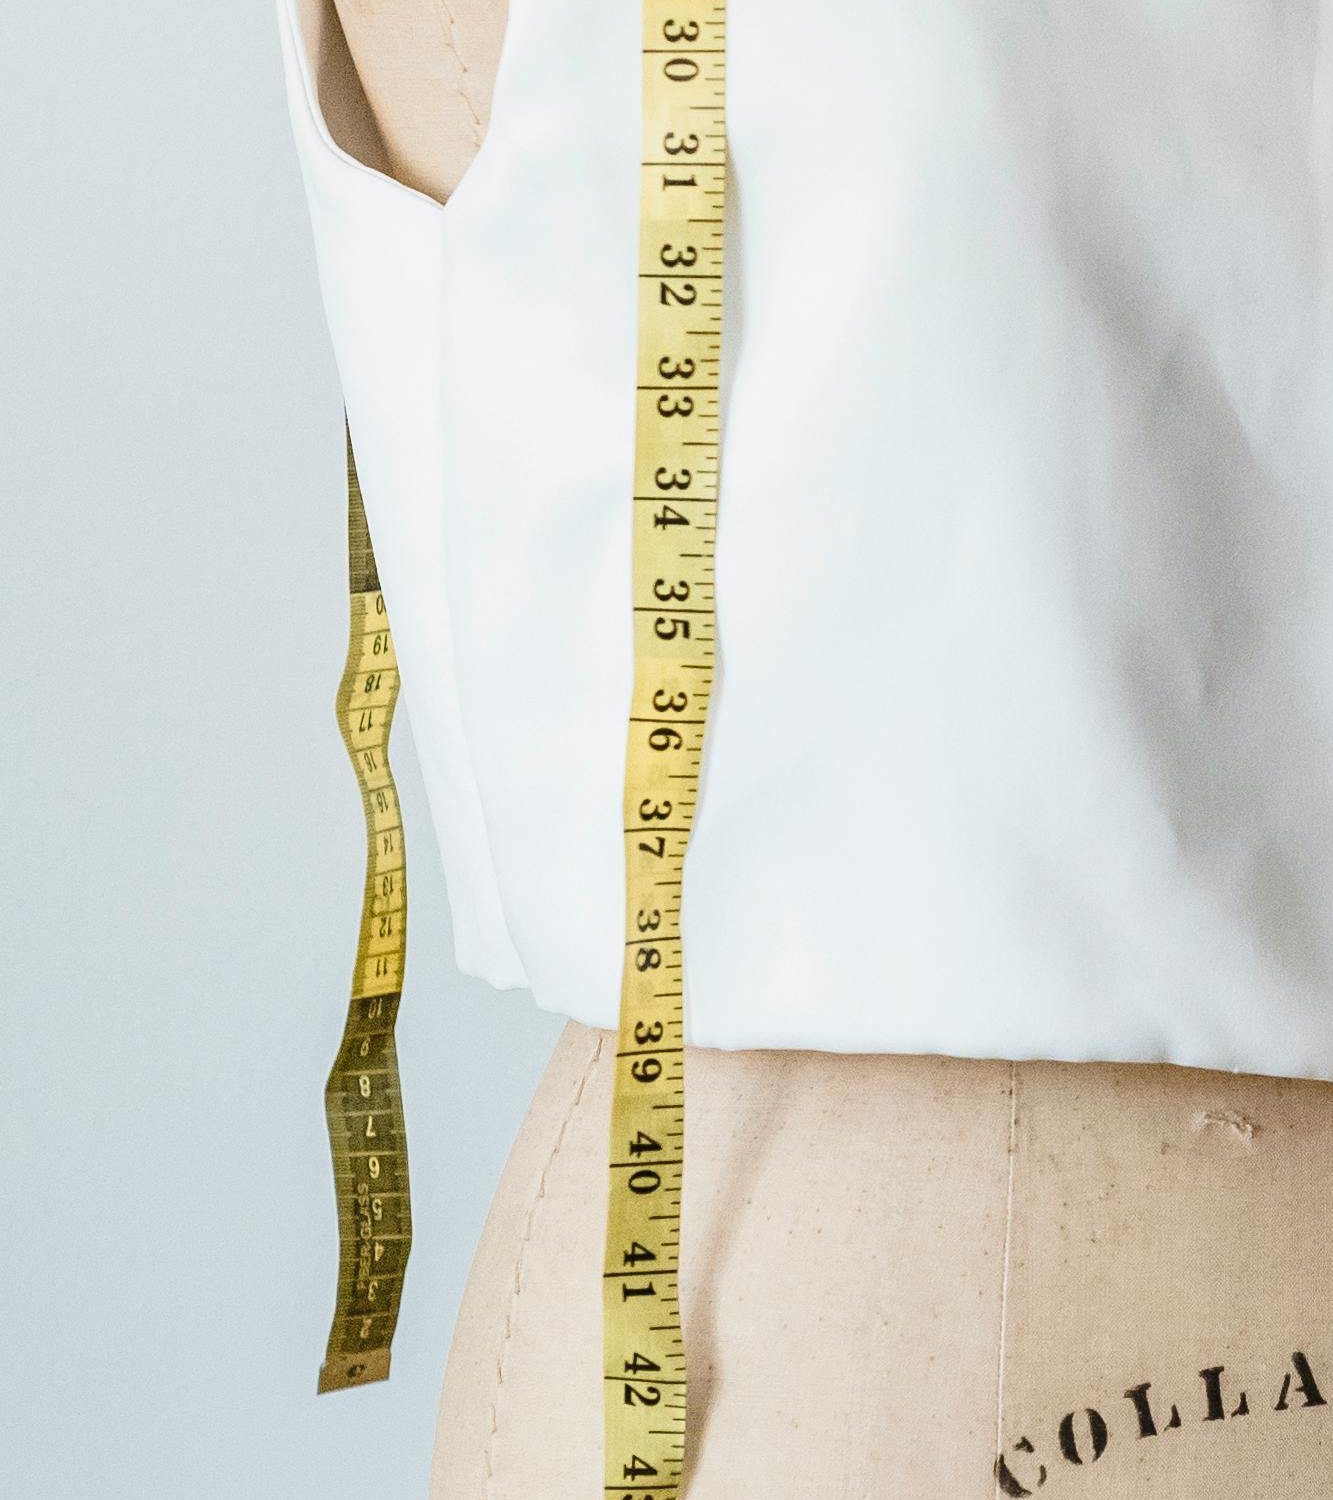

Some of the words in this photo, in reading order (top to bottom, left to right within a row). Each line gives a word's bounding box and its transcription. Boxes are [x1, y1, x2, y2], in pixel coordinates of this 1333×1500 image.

[663, 19, 700, 82] 30
[663, 132, 700, 191] 31
[661, 244, 698, 307] 32
[658, 356, 696, 418] 33
[654, 466, 693, 530] 34
[655, 579, 691, 641] 35
[373, 635, 389, 655] 19
[365, 674, 382, 693] 18
[358, 711, 373, 732] 17
[649, 689, 688, 752] 36
[364, 752, 377, 773] 16
[376, 792, 389, 813] 15
[639, 799, 671, 858] 37
[383, 834, 393, 854] 14
[382, 876, 394, 896] 13
[379, 917, 392, 937] 12
[636, 909, 661, 973] 38
[376, 959, 387, 977] 11
[368, 998, 383, 1019] 10
[360, 1036, 370, 1056] 9
[633, 1020, 664, 1084] 39
[359, 1075, 371, 1097] 8
[366, 1116, 376, 1136] 7
[368, 1156, 379, 1178] 6
[629, 1131, 662, 1195] 40
[371, 1198, 382, 1220] 5
[373, 1243, 384, 1261] 4
[623, 1241, 658, 1301] 41
[625, 1352, 663, 1406] 42
